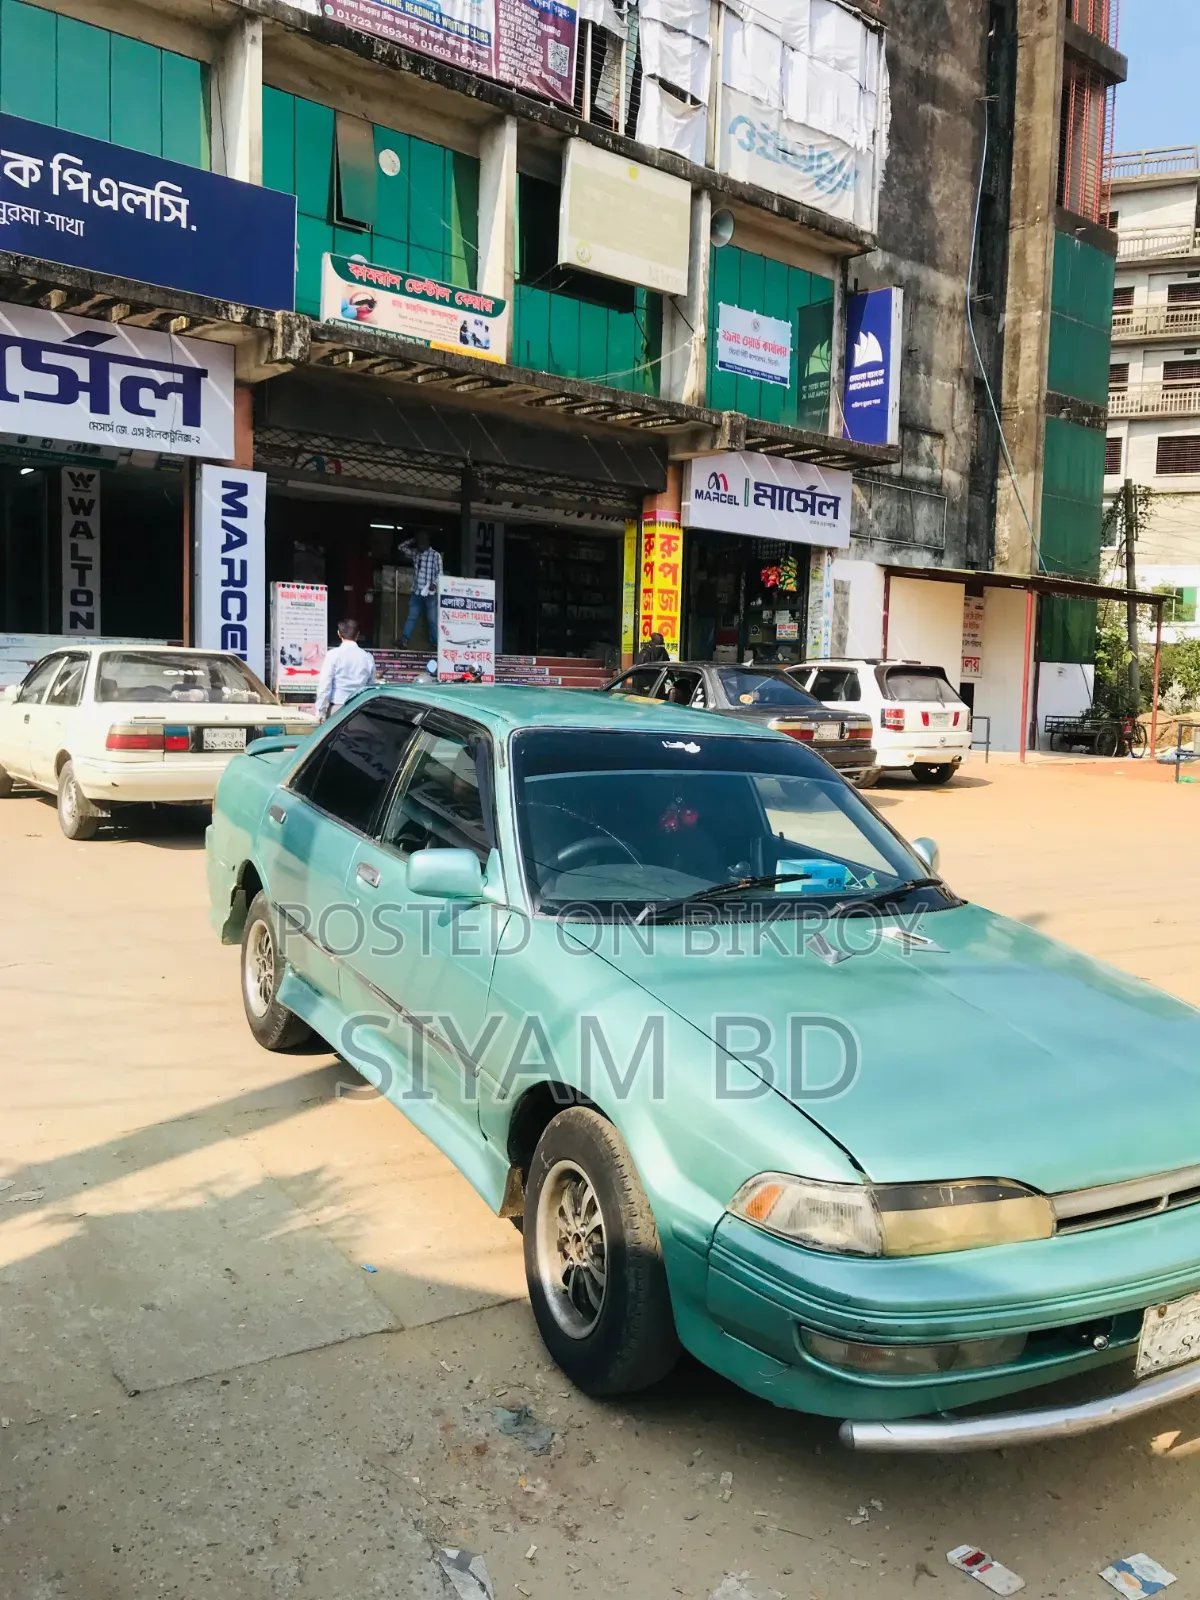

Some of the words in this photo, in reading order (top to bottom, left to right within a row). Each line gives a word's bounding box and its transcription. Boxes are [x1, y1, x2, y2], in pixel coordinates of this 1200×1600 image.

[336, 9, 372, 28] 01722
[421, 40, 452, 58] 01603
[454, 52, 489, 72] 160622
[405, 1, 434, 21] READING
[470, 26, 489, 43] CLUBS
[50, 152, 197, 231] পিএলসি.
[44, 211, 84, 236] শাখা
[347, 262, 402, 290] কামরান
[405, 278, 452, 302] ডেন্টাল
[455, 291, 494, 314] কেয়ার
[870, 378, 884, 387] BANK
[89, 421, 114, 433] মেসার্স
[116, 425, 129, 435] জে.
[131, 427, 144, 438] এস
[695, 489, 739, 506] MARCEL
[754, 481, 841, 520] মার্সেল
[67, 496, 96, 630] WALTON
[451, 611, 470, 620] ALIGHT
[471, 613, 493, 622] TRAVELS
